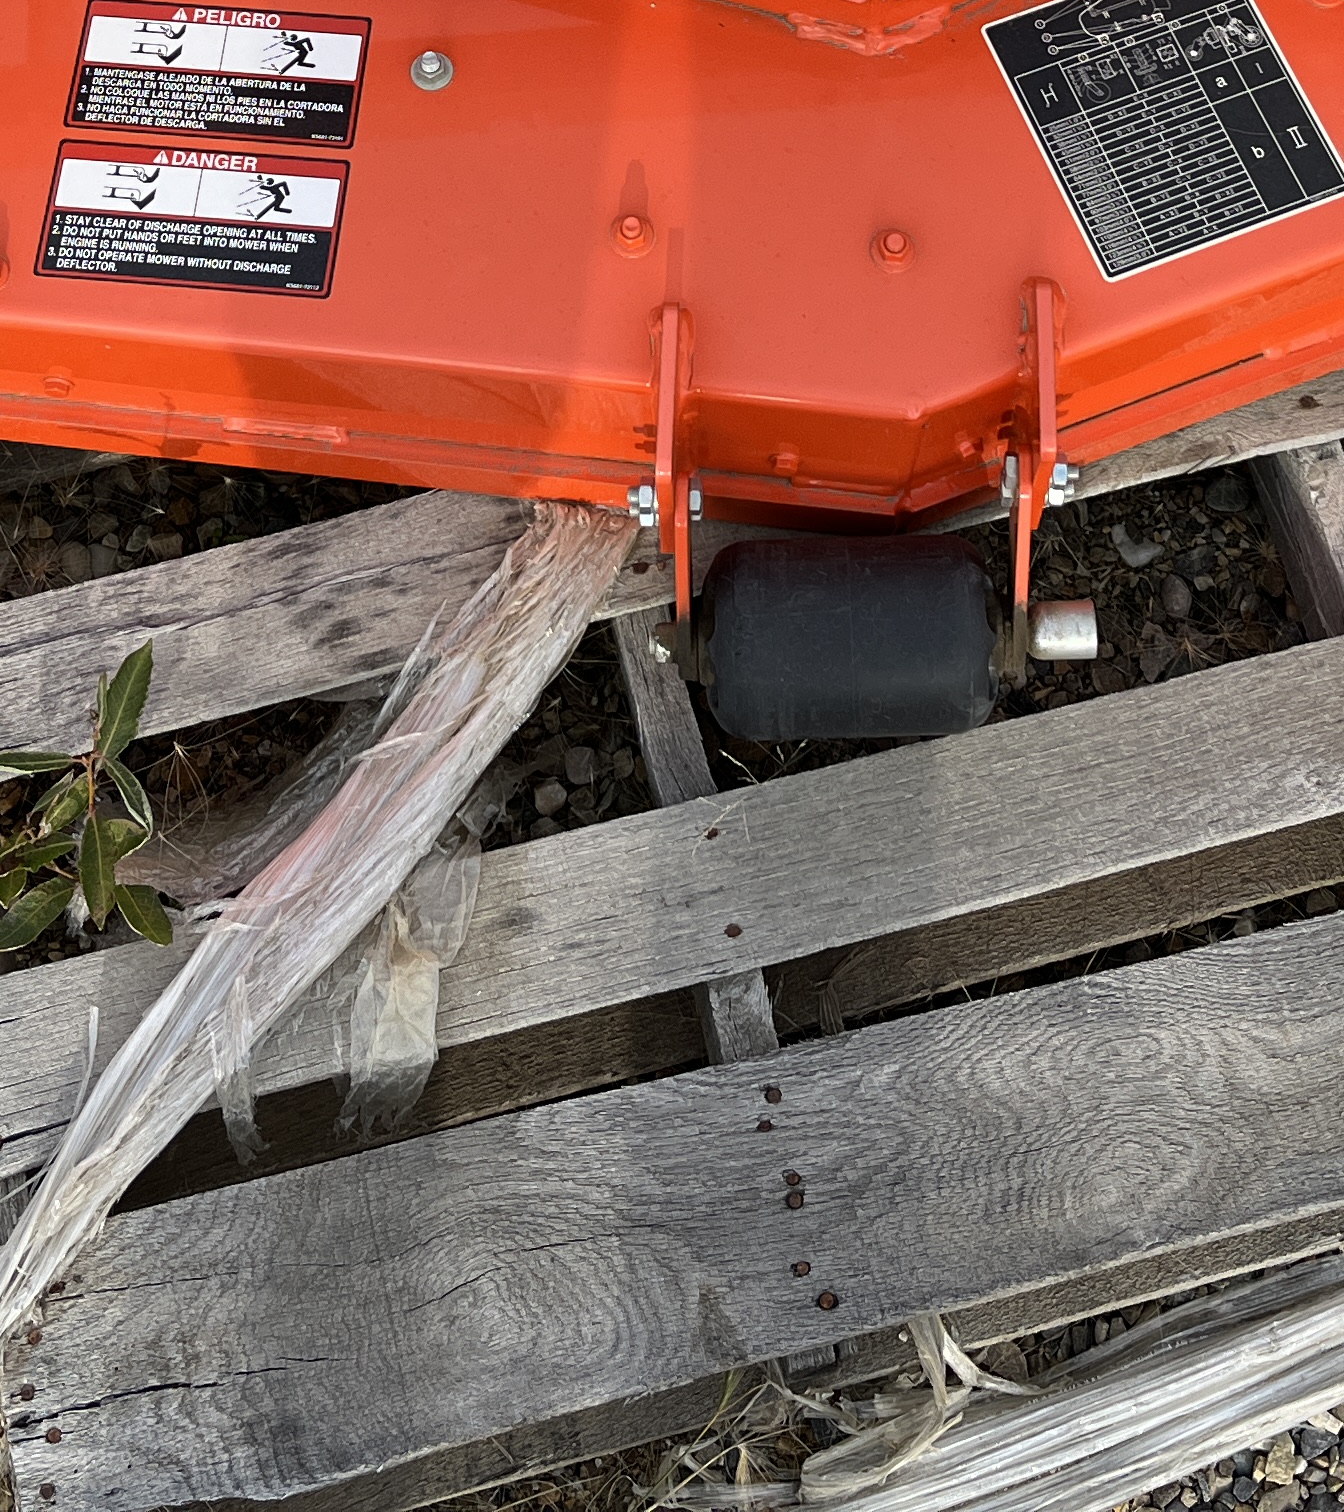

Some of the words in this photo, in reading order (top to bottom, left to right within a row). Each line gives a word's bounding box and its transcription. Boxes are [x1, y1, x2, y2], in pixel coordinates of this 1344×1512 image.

[192, 8, 282, 29] PELIGRO
[91, 76, 143, 88] DESCARGA
[143, 80, 157, 89] EN
[157, 81, 184, 91] TODO
[184, 83, 234, 95] MOMENTO.
[92, 67, 157, 80] MANTENGASE
[156, 72, 200, 83] ALEJADO
[200, 75, 214, 85] DE
[214, 76, 228, 86] LA
[228, 77, 278, 89] ABERTURA
[278, 81, 293, 90] DE
[293, 82, 306, 91] LA
[87, 94, 135, 106] MIENTRAS
[135, 97, 148, 107] EL
[148, 98, 183, 110] MOTOR
[209, 103, 223, 113] EN
[223, 104, 306, 119] FUNCIONAMIENTO.
[89, 85, 105, 95] NO
[104, 86, 151, 98] COLOQUE
[150, 89, 170, 99] LAS
[170, 91, 204, 102] MANOS
[204, 93, 216, 103] NI
[216, 94, 238, 105] LOS
[238, 96, 258, 106] PIES
[258, 97, 272, 107] EN
[272, 98, 286, 108] LA
[286, 99, 344, 112] CORTADORA
[84, 111, 139, 125] DEFLECTOR
[139, 115, 154, 126] DE
[154, 116, 208, 130] DESCARGA.
[85, 102, 101, 113] NO
[101, 104, 129, 115] HAGA
[129, 106, 183, 119] FUNCIONAR
[183, 110, 197, 120] LA
[197, 111, 255, 124] CORTADORA
[255, 115, 272, 126] SIN
[272, 117, 286, 127] EL
[170, 150, 258, 172] DANGER
[1250, 142, 1268, 160] b
[51, 223, 62, 233] 2.
[61, 224, 79, 235] DO
[79, 225, 101, 237] NOT
[101, 227, 123, 239] PUT
[123, 229, 159, 242] HANDS
[159, 232, 176, 243] OR
[176, 234, 203, 245] FEET
[203, 236, 228, 248] INTO
[228, 238, 268, 251] MOWER
[268, 241, 299, 254] WHEN
[53, 212, 65, 223] 1.
[63, 213, 92, 226] STAY
[91, 215, 127, 229] CLEAR
[127, 218, 143, 230] OF
[143, 220, 202, 235] DISCHARGE
[201, 224, 248, 239] OPENING
[248, 228, 264, 240] AT
[263, 230, 285, 242] ALL
[284, 231, 318, 245] TIMES.
[59, 235, 99, 248] ENGINE
[98, 238, 110, 249] IS
[110, 239, 160, 253] RUNNING.
[47, 245, 58, 255] 3.
[57, 246, 75, 257] DO
[74, 247, 97, 259] NOT
[97, 249, 146, 263] OPERATE
[146, 253, 185, 266] MOWER
[185, 257, 232, 270] WITHOUT
[232, 261, 292, 275] DISCHARGE
[55, 257, 119, 272] DEFLECTOR.
